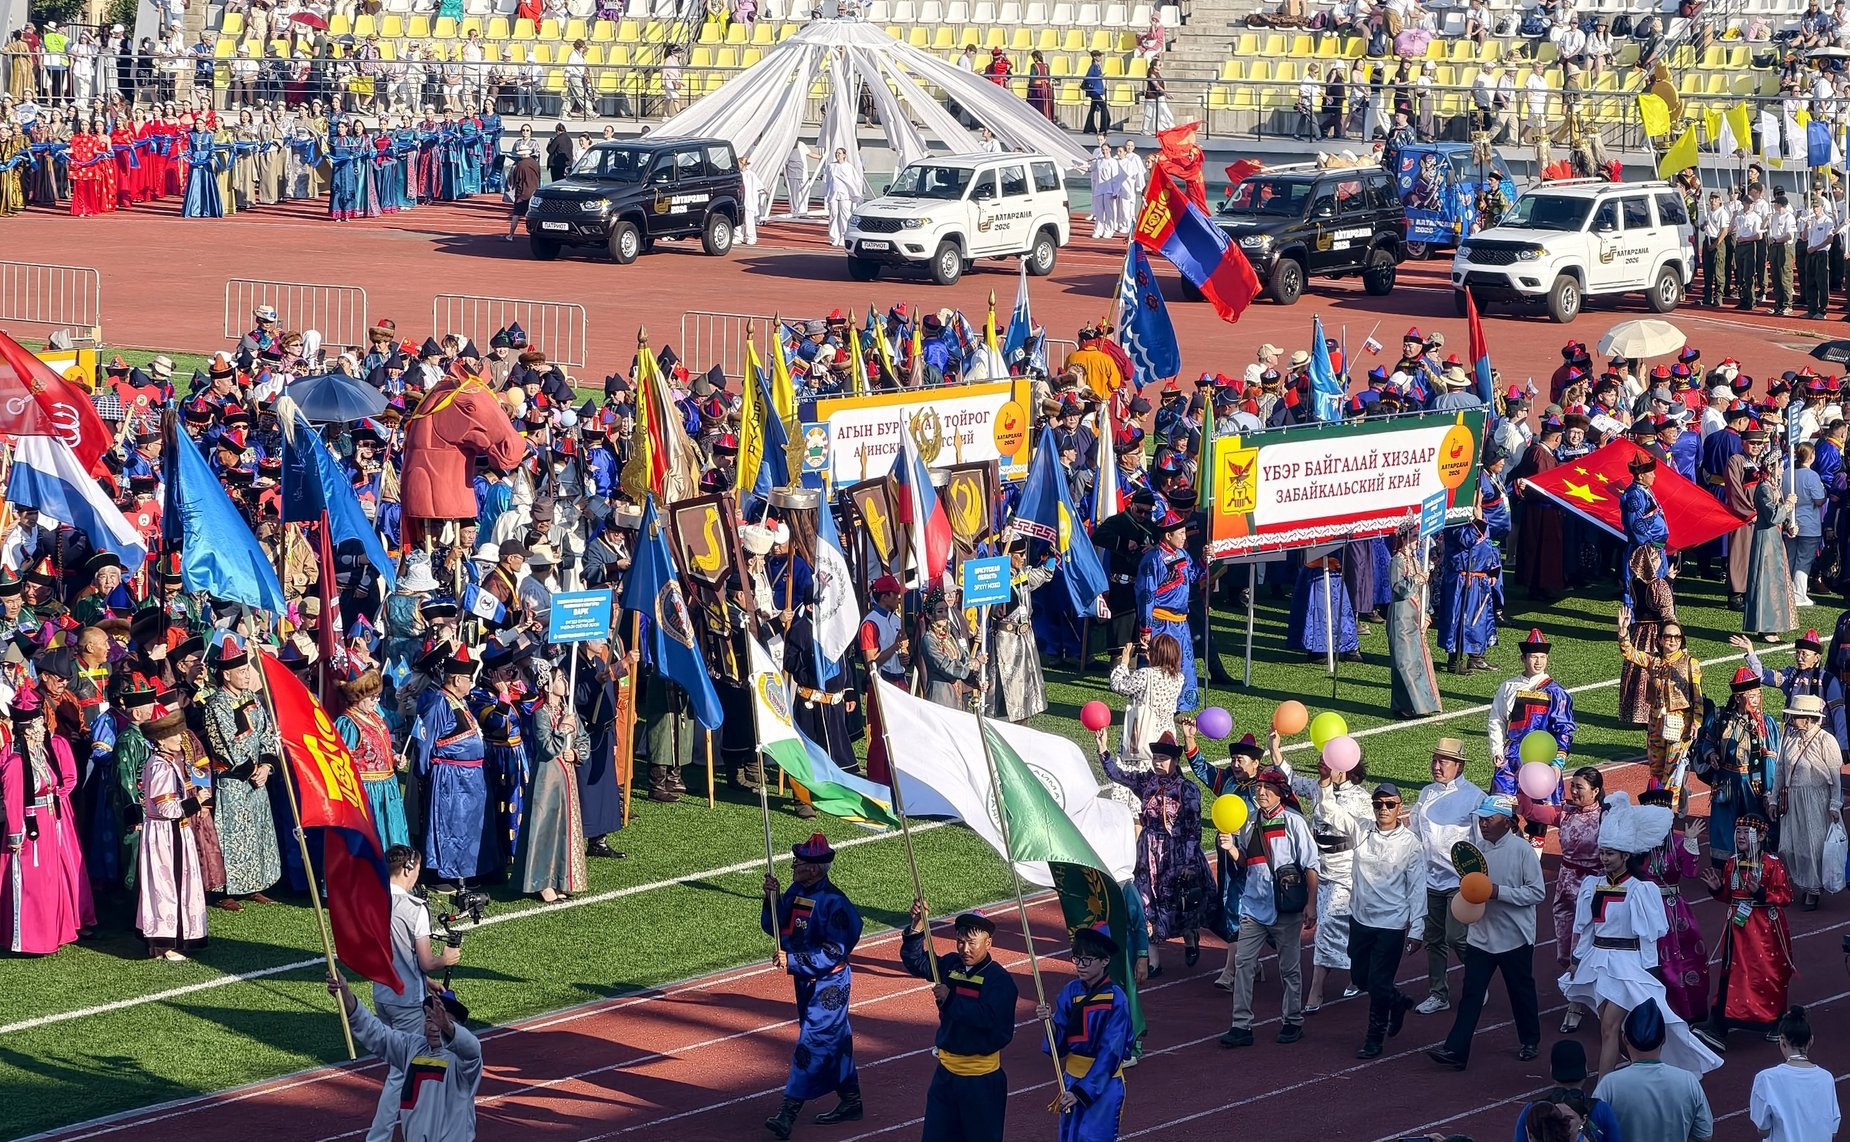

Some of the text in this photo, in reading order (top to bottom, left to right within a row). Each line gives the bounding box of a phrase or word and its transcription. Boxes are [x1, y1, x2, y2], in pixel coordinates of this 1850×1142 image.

[995, 222, 1010, 230] 2026
[837, 424, 873, 440] АГЫН
[944, 409, 990, 428] ТОЙРОГ
[1304, 449, 1378, 477] БАЙГАЛАЙ
[1382, 448, 1436, 468] ХИЗААР
[1276, 468, 1421, 504] ЗАБАЙКАЛЬСКИЙ КРАЙ
